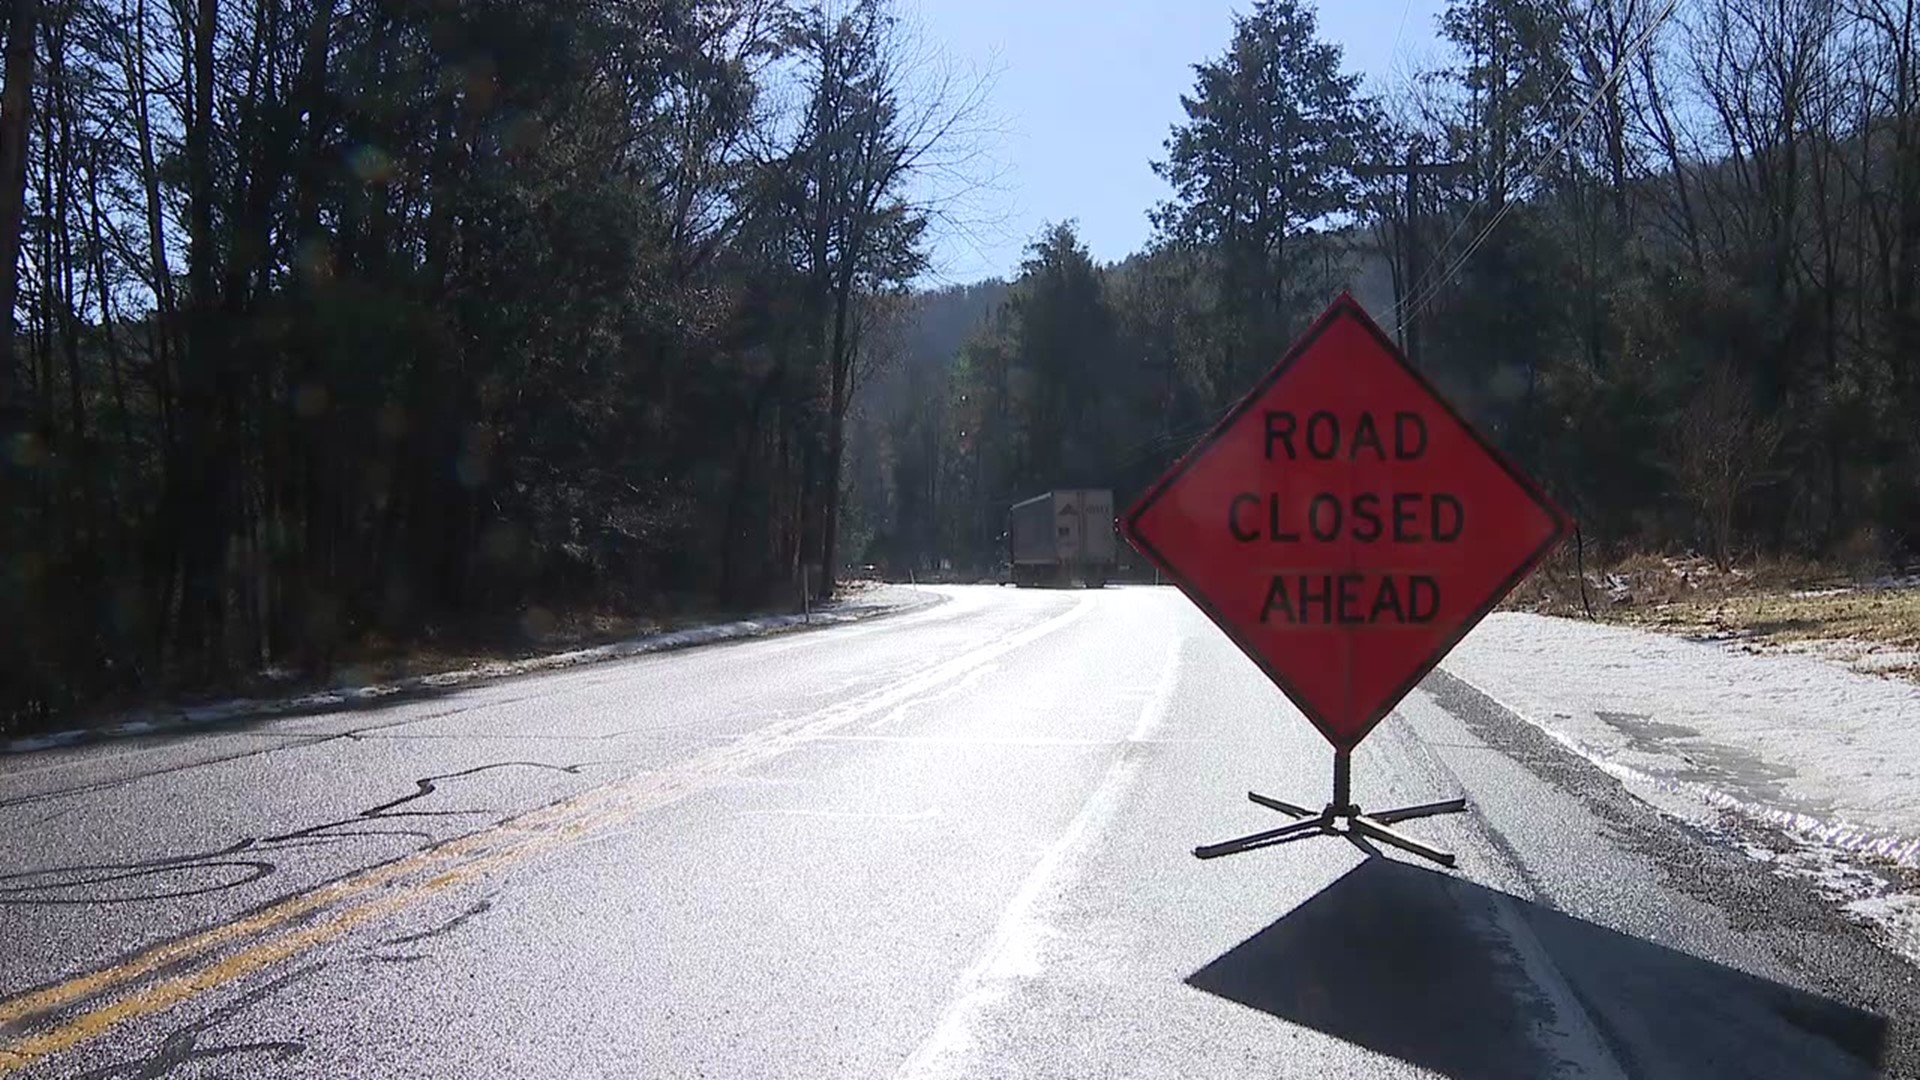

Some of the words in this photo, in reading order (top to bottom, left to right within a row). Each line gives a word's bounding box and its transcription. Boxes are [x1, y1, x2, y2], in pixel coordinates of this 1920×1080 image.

[1264, 410, 1428, 461] ROAD
[1228, 492, 1464, 543] CLOSED
[1260, 574, 1440, 625] AHEAD
